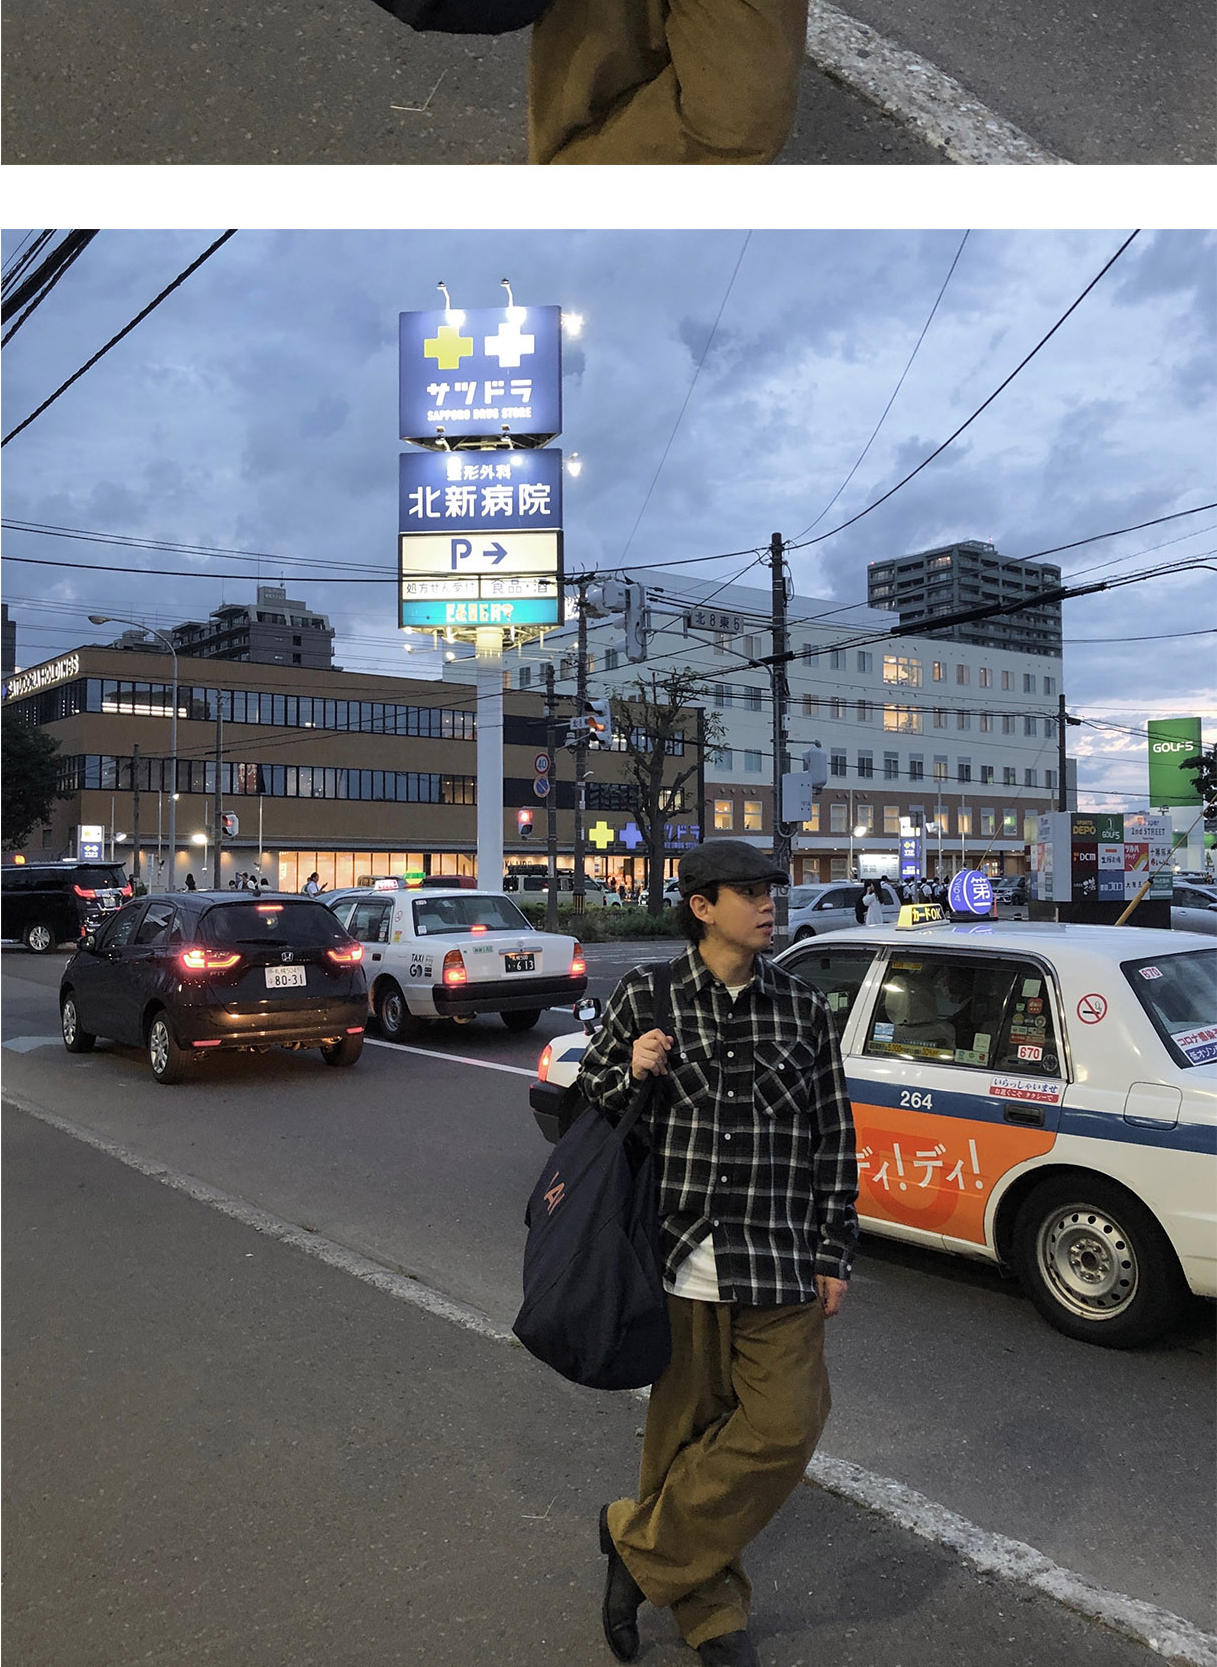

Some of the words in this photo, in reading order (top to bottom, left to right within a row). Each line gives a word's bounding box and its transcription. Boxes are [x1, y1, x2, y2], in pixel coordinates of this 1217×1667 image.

[427, 379, 532, 406] サツドラ
[427, 409, 470, 421] SAPPORO
[473, 408, 499, 420] DRUG
[501, 407, 532, 419] STORE
[408, 483, 551, 518] 北新病院
[451, 538, 472, 570] P
[1152, 741, 1194, 753] GOLF5
[1072, 826, 1096, 835] DEPO
[1144, 827, 1165, 836] STREET
[1142, 966, 1161, 979] 670
[275, 974, 304, 986] 80-31
[1019, 1046, 1040, 1060] 670
[993, 1077, 1058, 1093] いらっしゃいませ
[900, 1090, 932, 1110] 264
